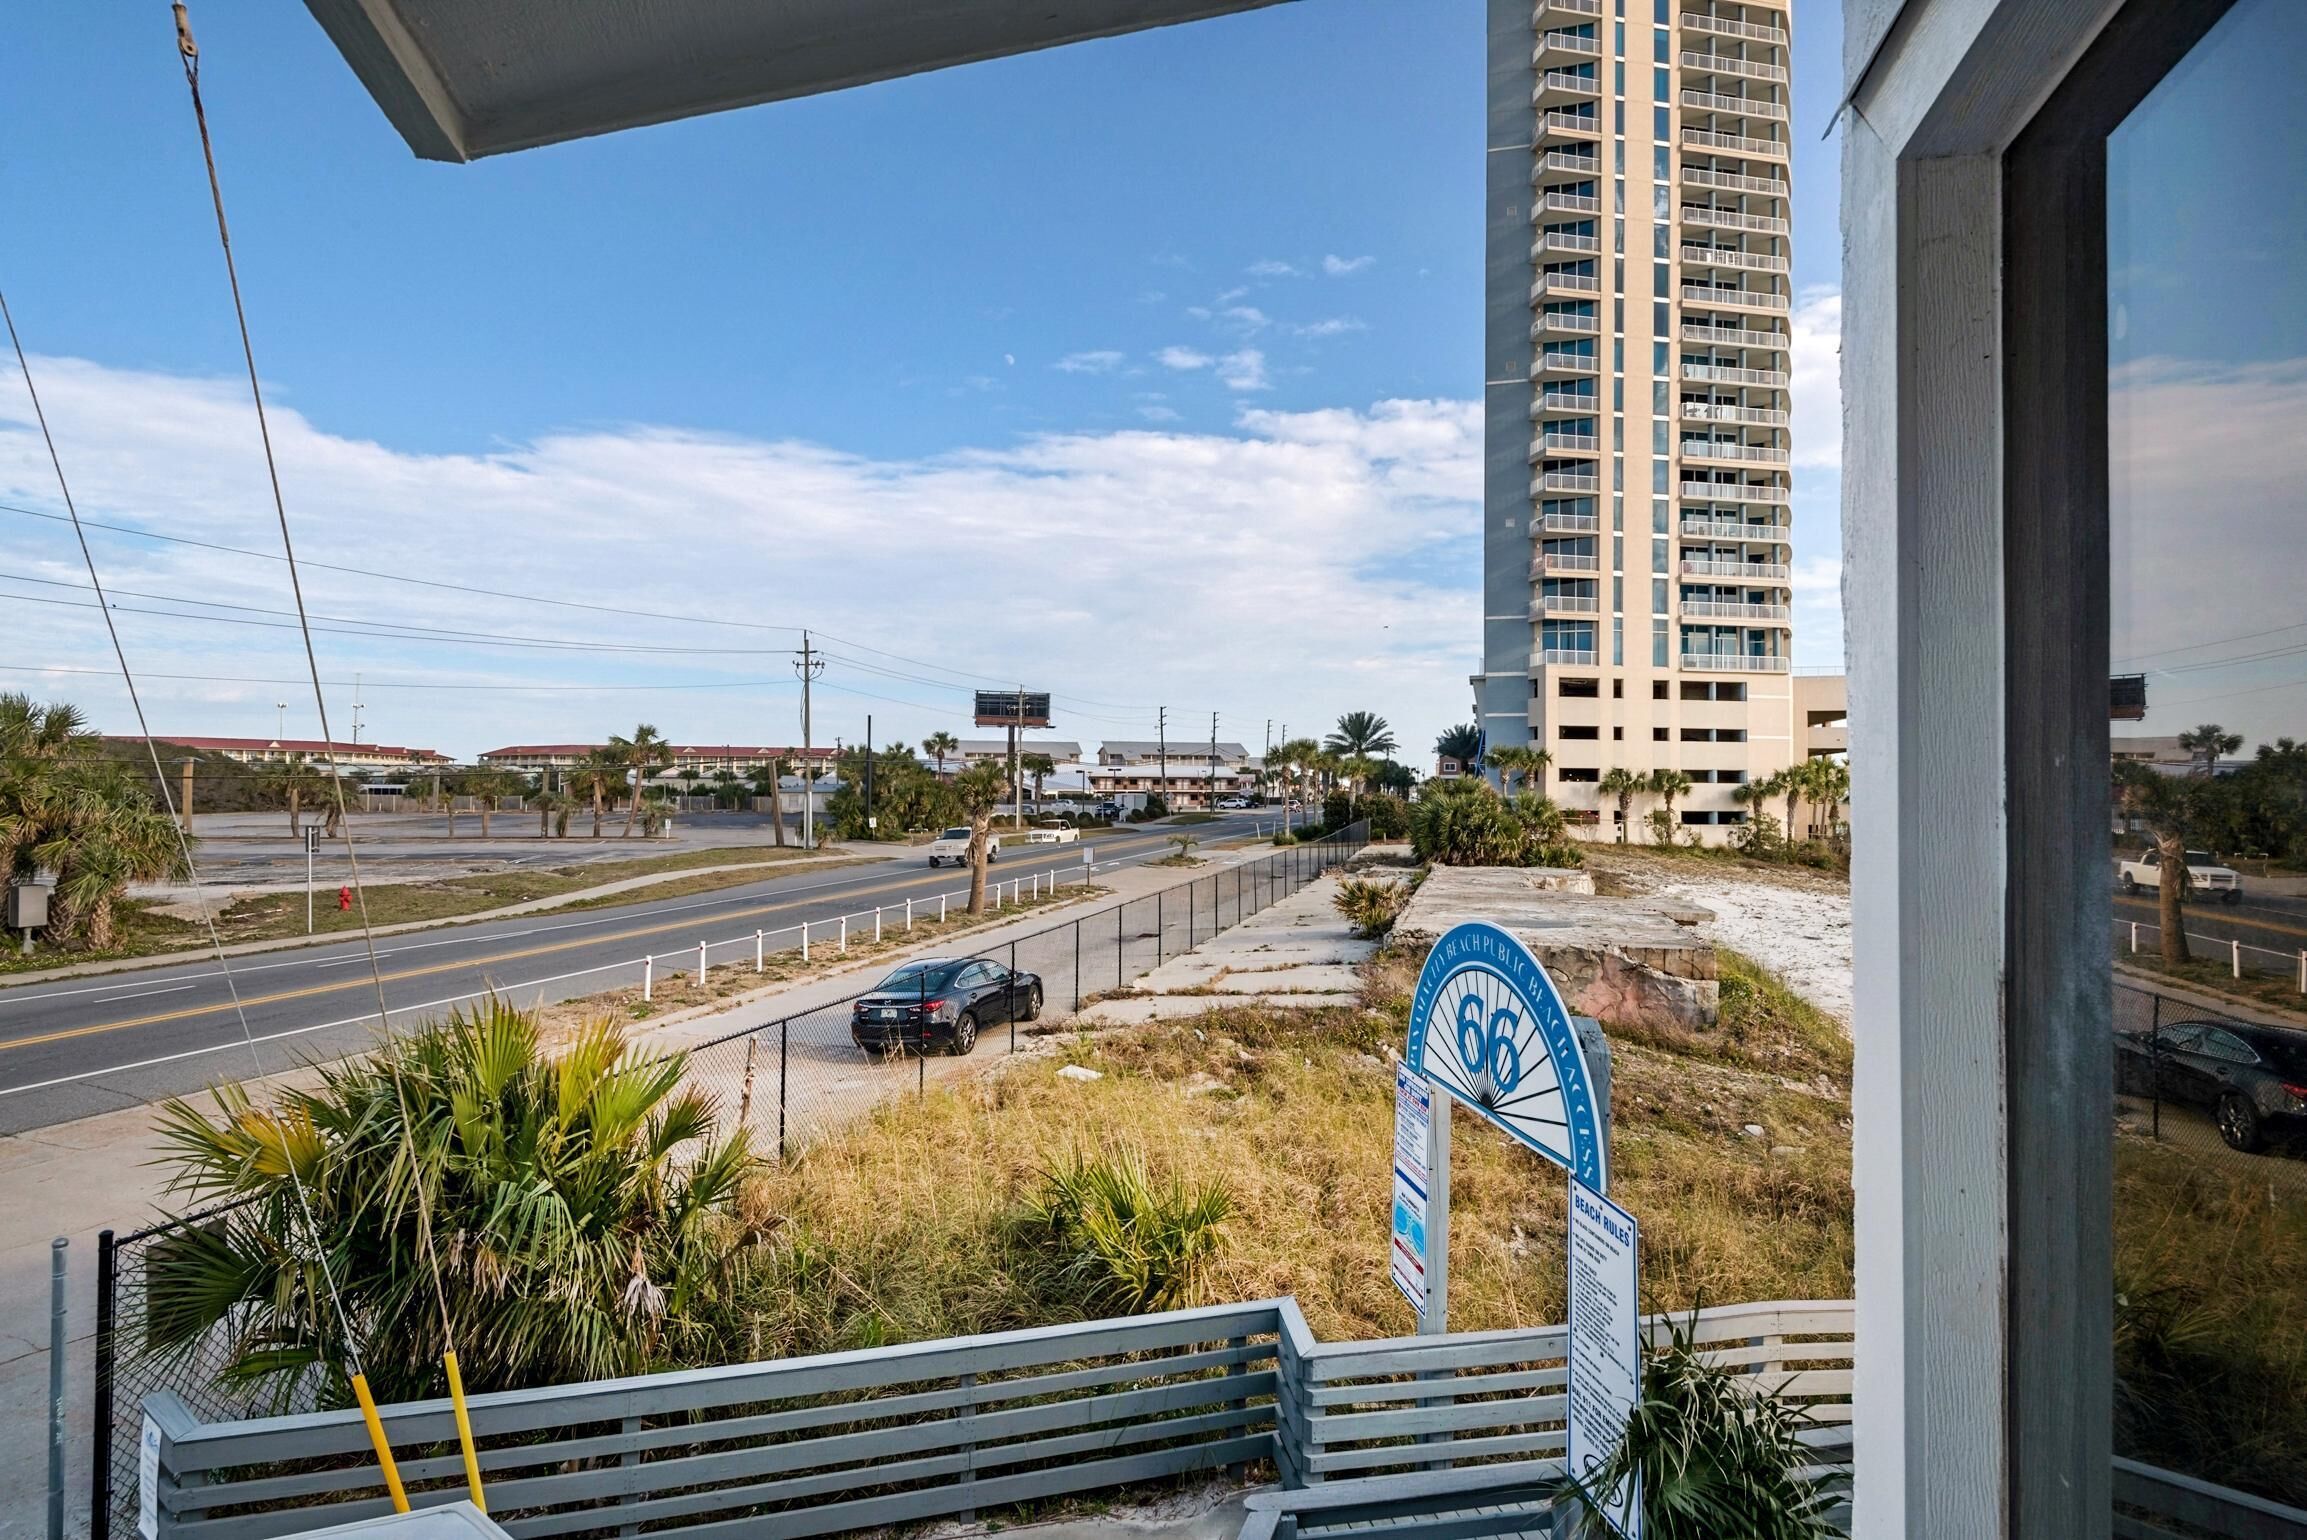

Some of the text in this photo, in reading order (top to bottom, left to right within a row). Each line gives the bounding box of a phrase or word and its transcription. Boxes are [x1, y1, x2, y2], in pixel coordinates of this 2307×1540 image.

[1445, 934, 1480, 961] BEACH
[1483, 935, 1526, 982] PUBLIC
[1457, 993, 1520, 1093] 66
[1575, 1194, 1630, 1248] BEACH RULES
